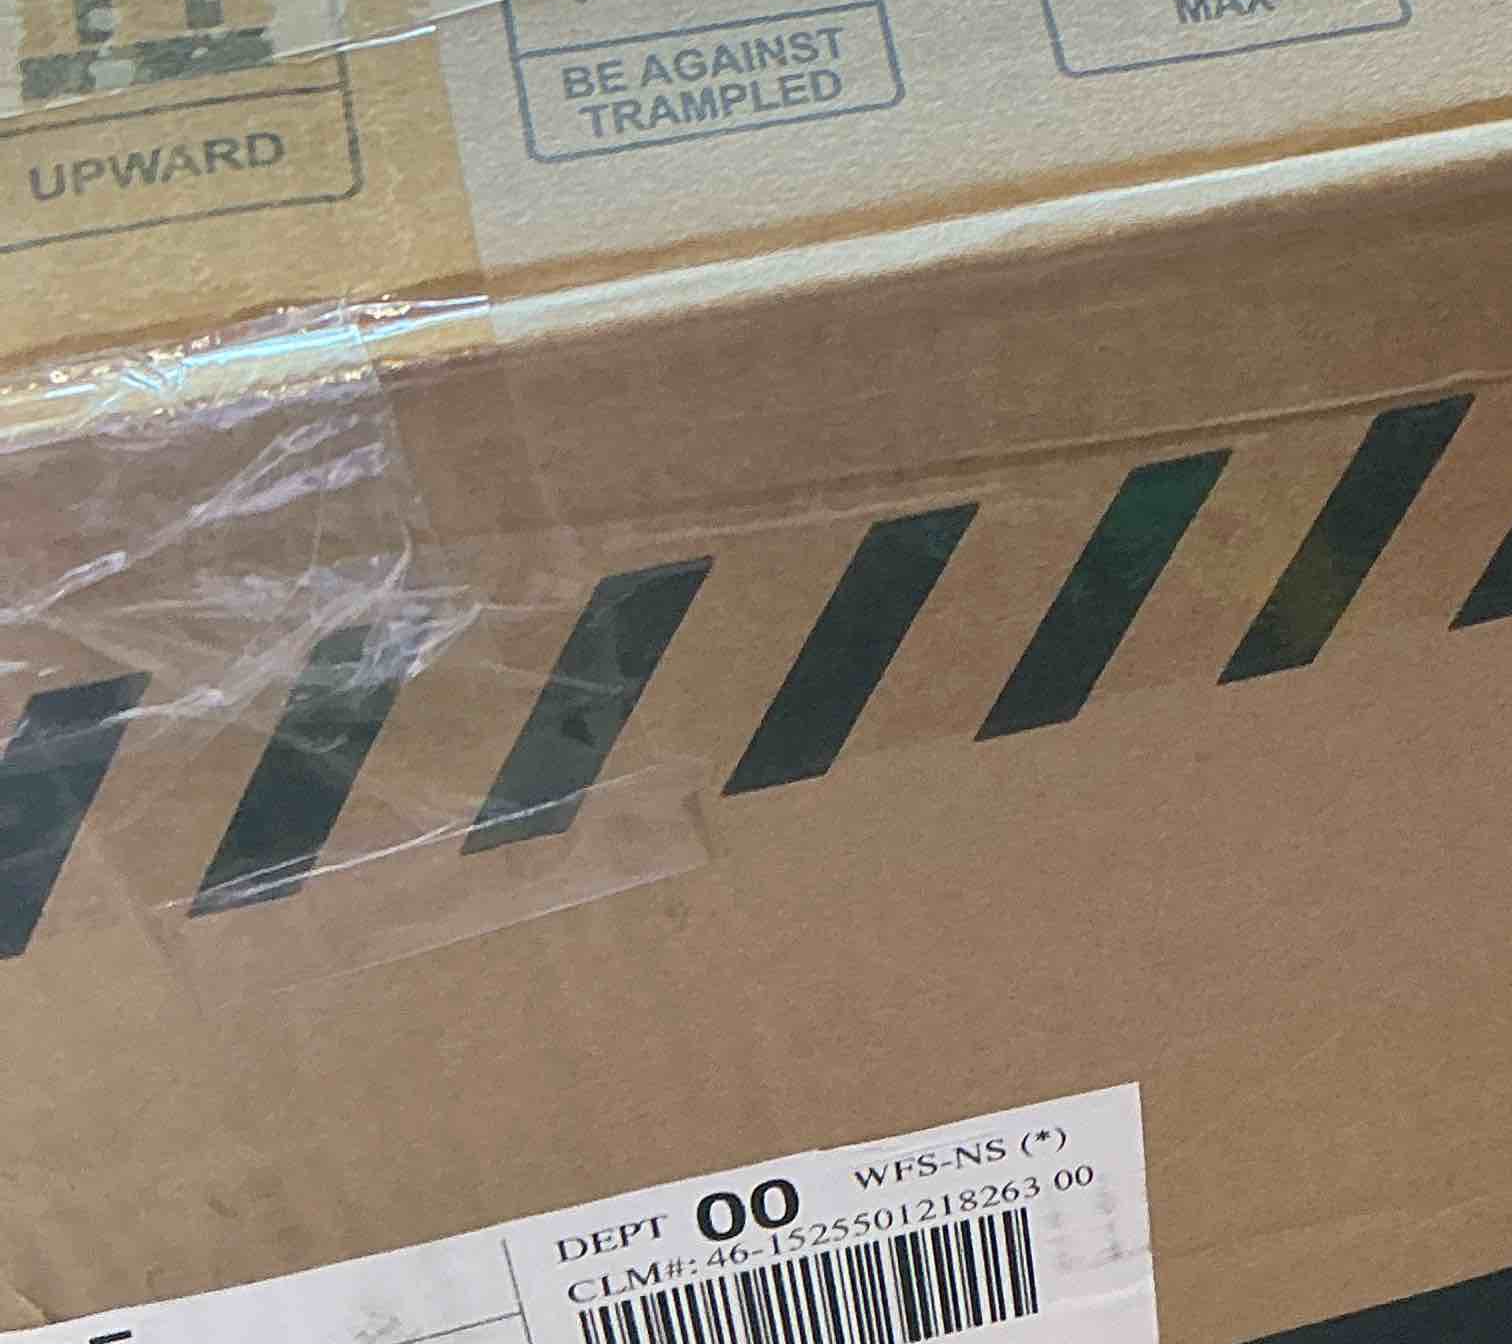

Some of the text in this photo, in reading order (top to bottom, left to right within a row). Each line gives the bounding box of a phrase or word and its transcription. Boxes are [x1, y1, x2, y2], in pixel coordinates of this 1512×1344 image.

[562, 27, 845, 101] BE AGAINST
[577, 68, 843, 137] TRAMPLED
[28, 130, 287, 202] UPWARD
[557, 1213, 669, 1264] DEPT
[696, 1178, 800, 1242] 00
[855, 1138, 1007, 1190] WFS-NS
[567, 1165, 1095, 1304] CLM#: 46-1525501218263 00
